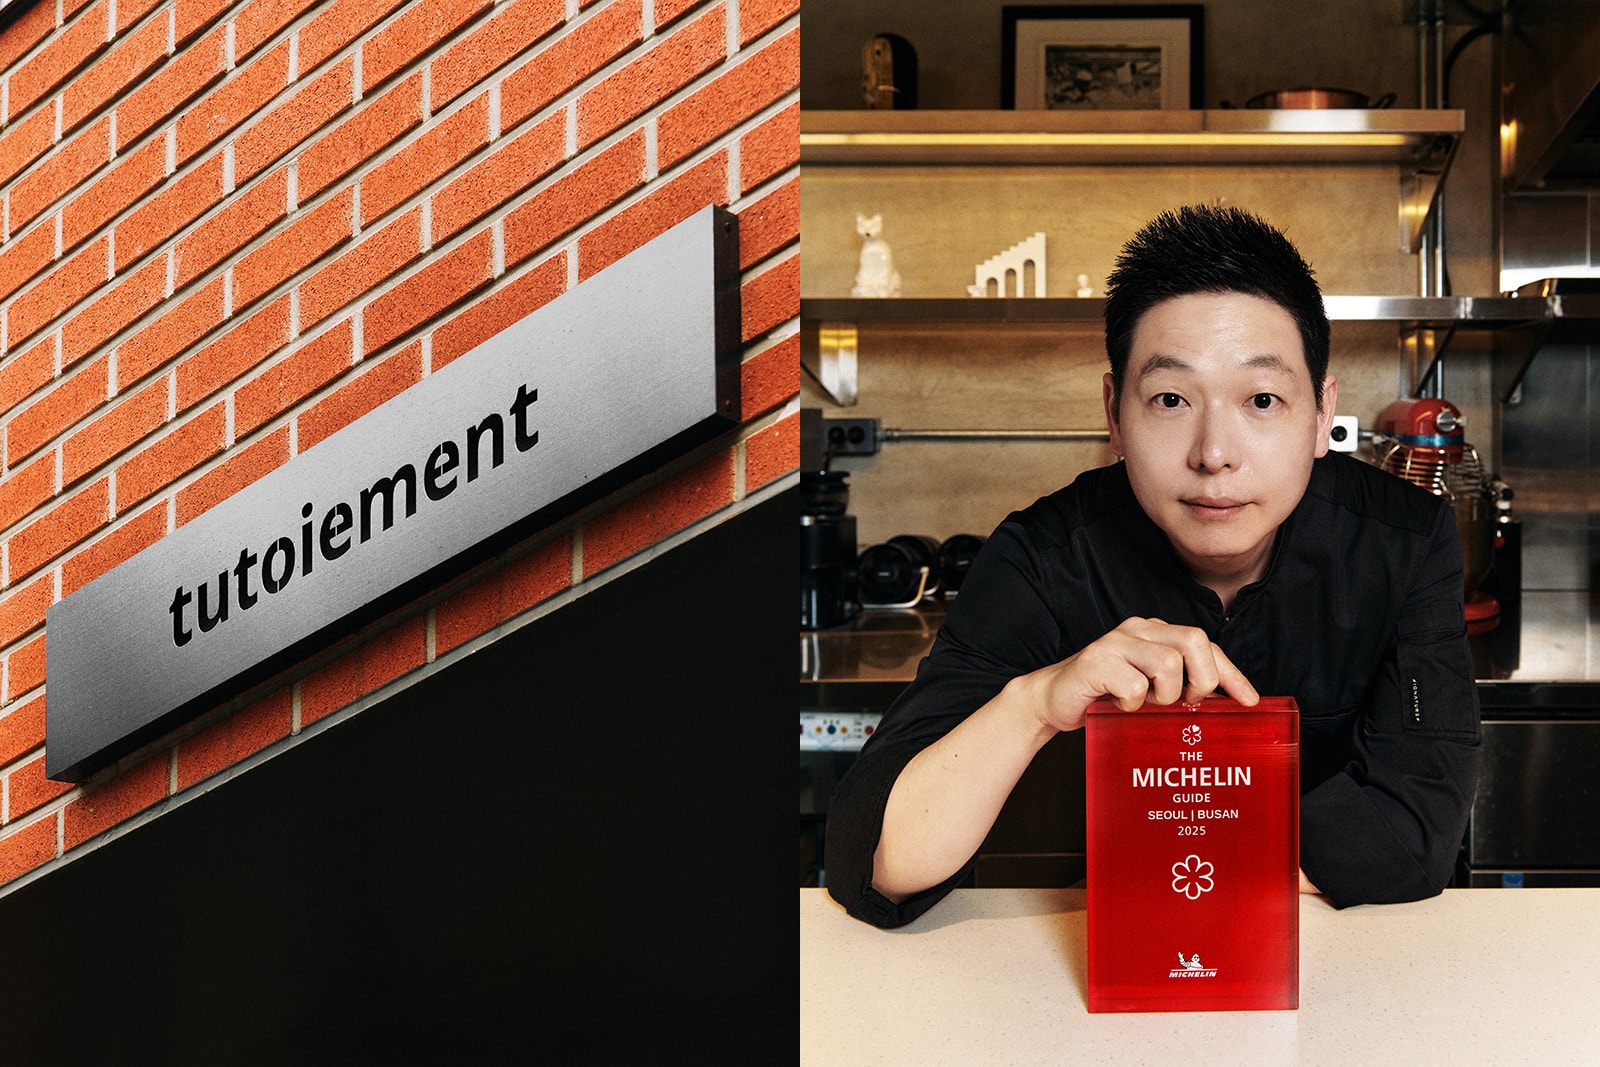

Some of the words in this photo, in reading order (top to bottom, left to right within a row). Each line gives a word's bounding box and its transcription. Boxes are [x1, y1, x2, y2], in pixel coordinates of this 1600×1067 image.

[168, 383, 539, 648] tutoiement
[1180, 751, 1203, 761] THE
[1132, 766, 1251, 788] MICHELIN
[1173, 792, 1211, 804] GUIDE
[1147, 810, 1188, 820] SEOUL
[1197, 809, 1239, 819] BUSAN
[1177, 826, 1206, 836] 2025
[1168, 969, 1217, 978] MICHELIN
